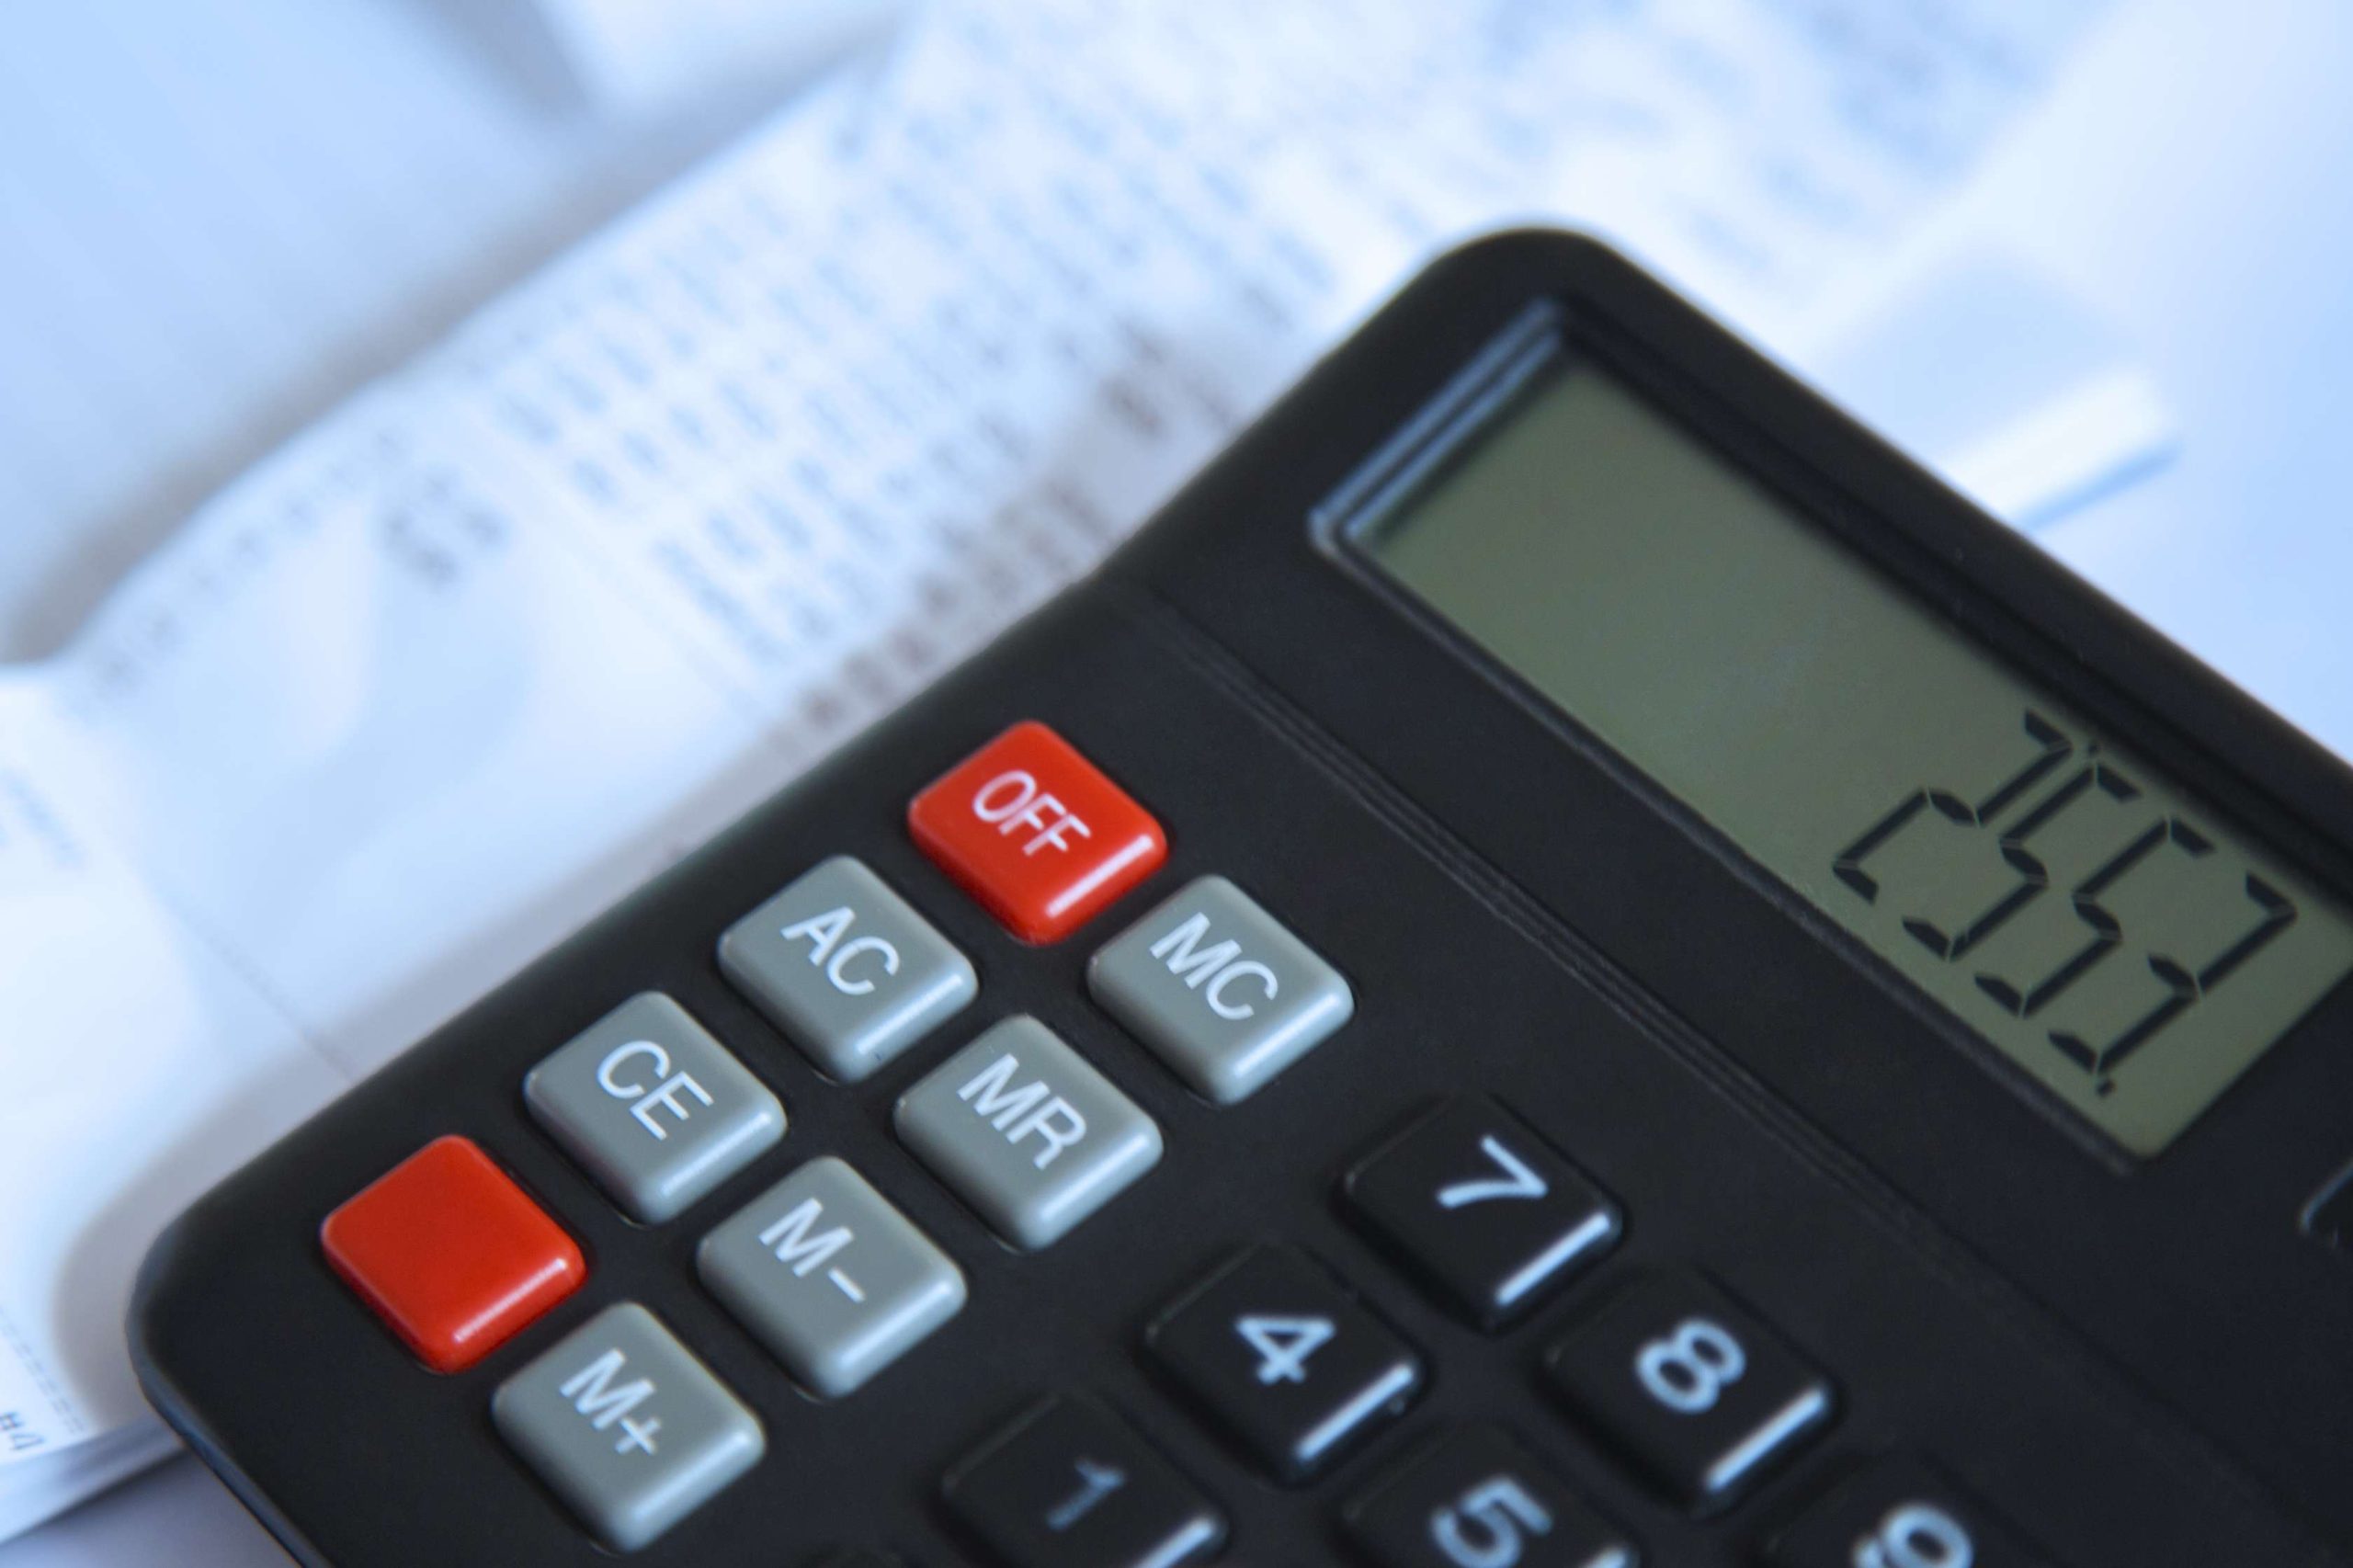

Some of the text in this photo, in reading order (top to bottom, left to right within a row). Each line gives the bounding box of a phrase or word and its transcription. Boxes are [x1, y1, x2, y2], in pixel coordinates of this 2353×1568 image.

[972, 769, 1092, 857] OFF
[780, 905, 901, 995] AC
[1149, 911, 1279, 1020] MC
[597, 1040, 714, 1141] CE
[957, 1053, 1087, 1170] MR
[1436, 1134, 1549, 1208] 7
[758, 1197, 865, 1303] M-
[1234, 1314, 1336, 1385] 4
[1635, 1319, 1746, 1413] 8
[560, 1347, 660, 1454] M+
[1048, 1459, 1125, 1532] 1
[1431, 1477, 1552, 1568] 5
